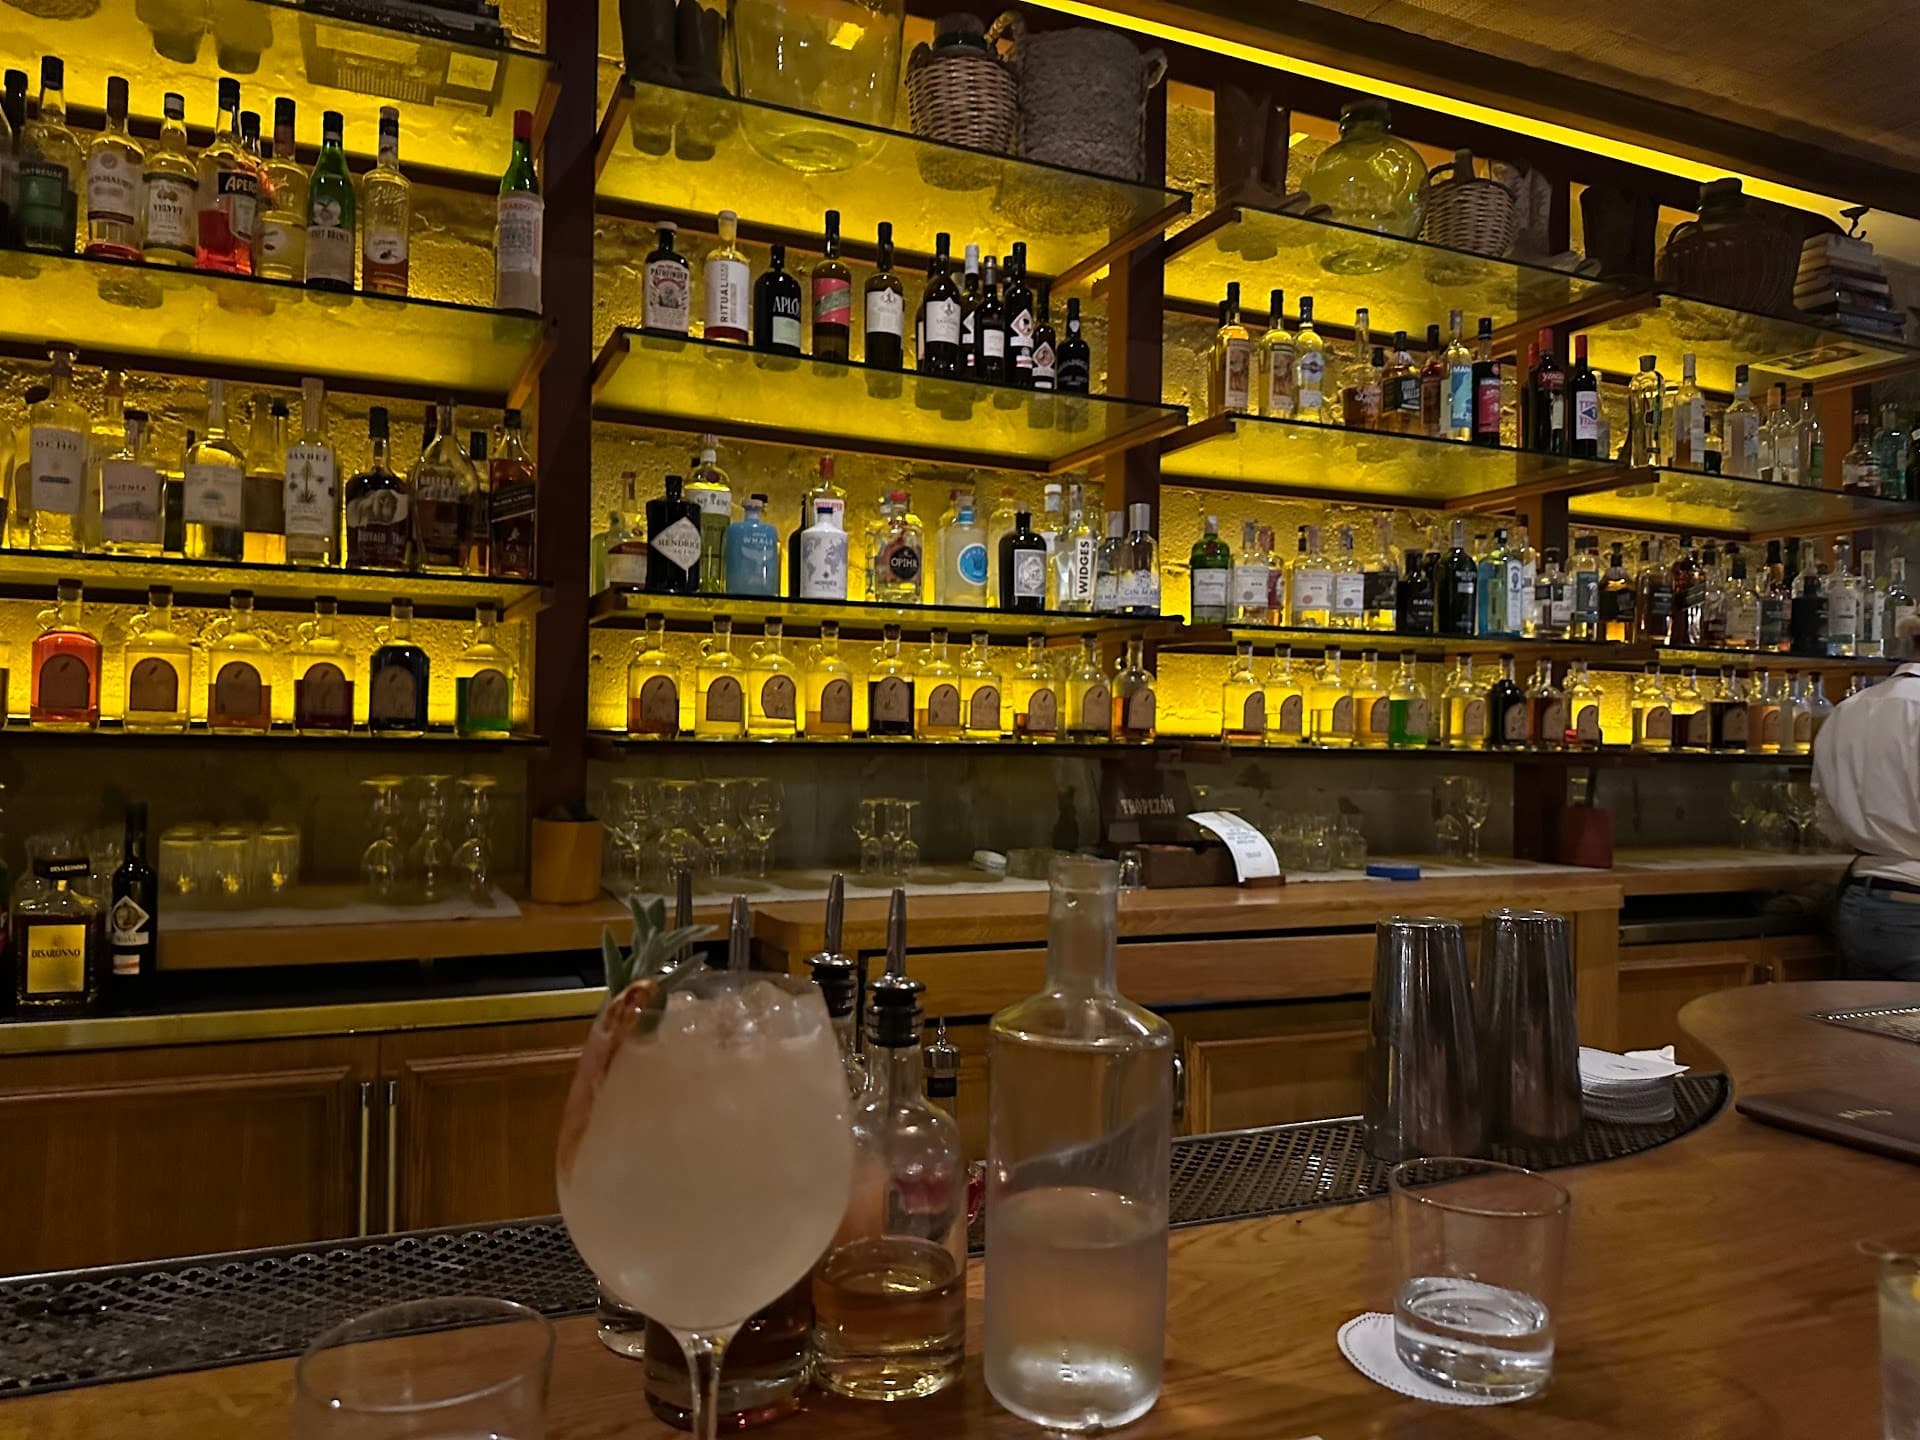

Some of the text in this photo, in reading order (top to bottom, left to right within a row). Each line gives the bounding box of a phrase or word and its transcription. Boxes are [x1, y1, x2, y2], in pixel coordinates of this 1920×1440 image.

[650, 267, 689, 281] PATHFINDER
[719, 283, 729, 323] RITUAL
[890, 556, 919, 569] OPIHR
[1078, 540, 1091, 595] WIDGES
[1120, 795, 1176, 814] TROPEZÓN
[31, 949, 81, 959] DISARONNO
